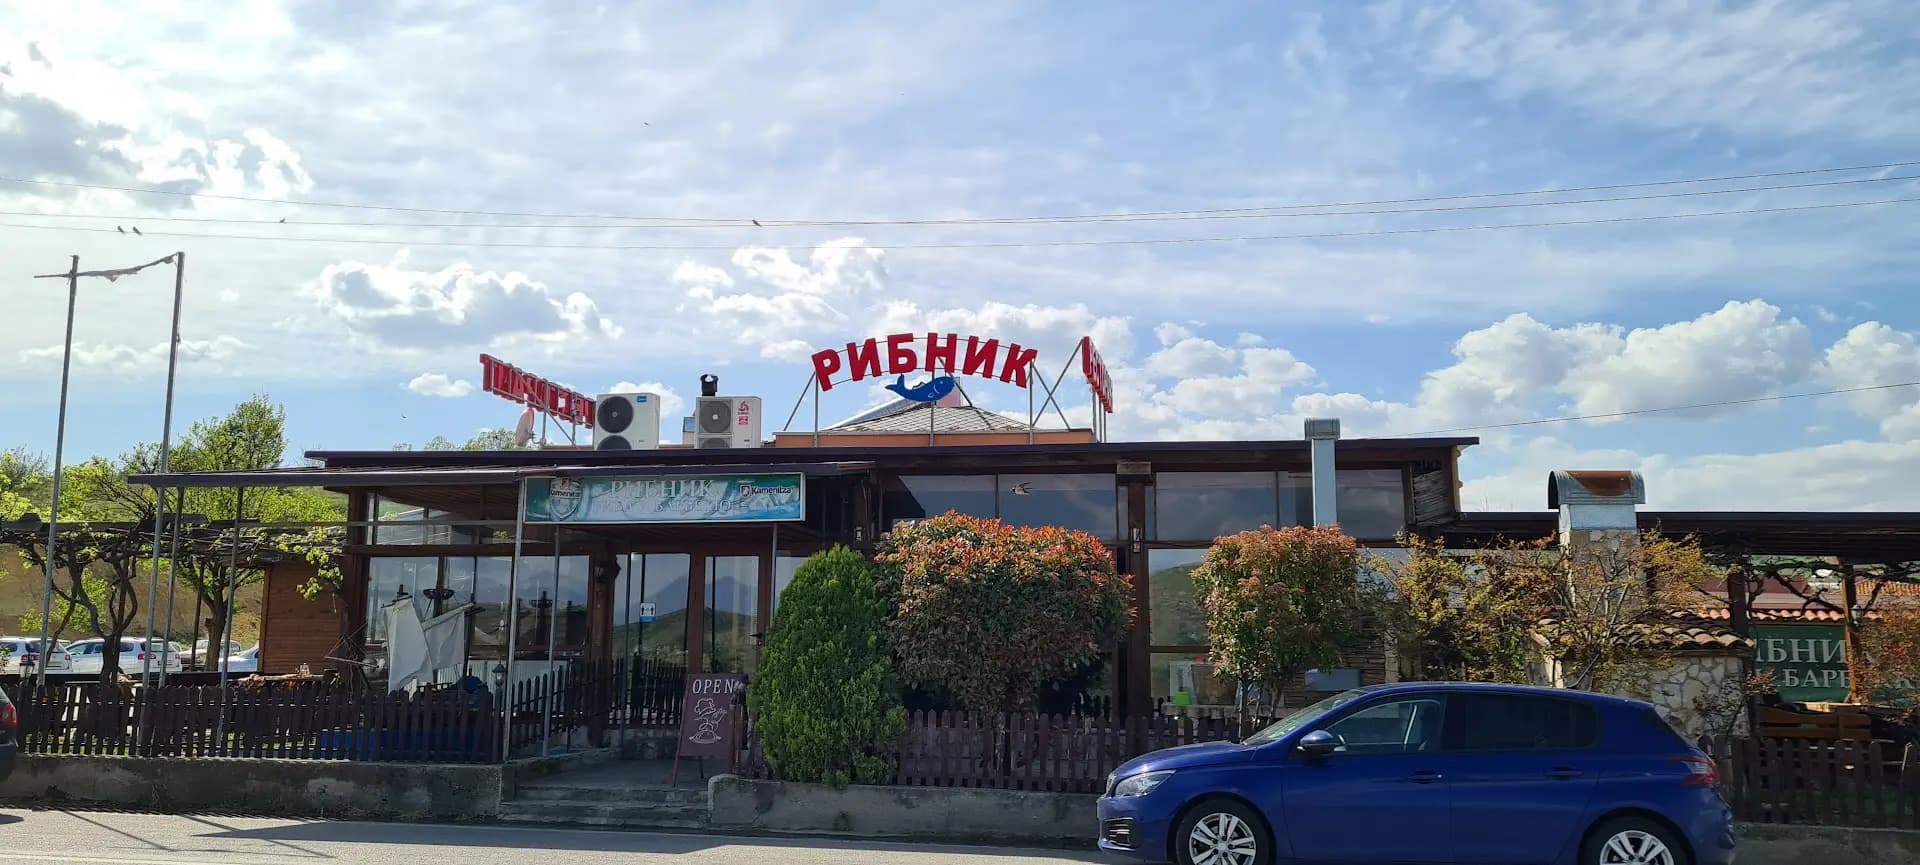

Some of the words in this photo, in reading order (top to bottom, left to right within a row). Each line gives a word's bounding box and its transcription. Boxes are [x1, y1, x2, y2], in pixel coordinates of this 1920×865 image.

[812, 333, 1038, 392] РИБНИК
[751, 487, 792, 495] Kamenitza
[692, 679, 735, 694] OPEN
